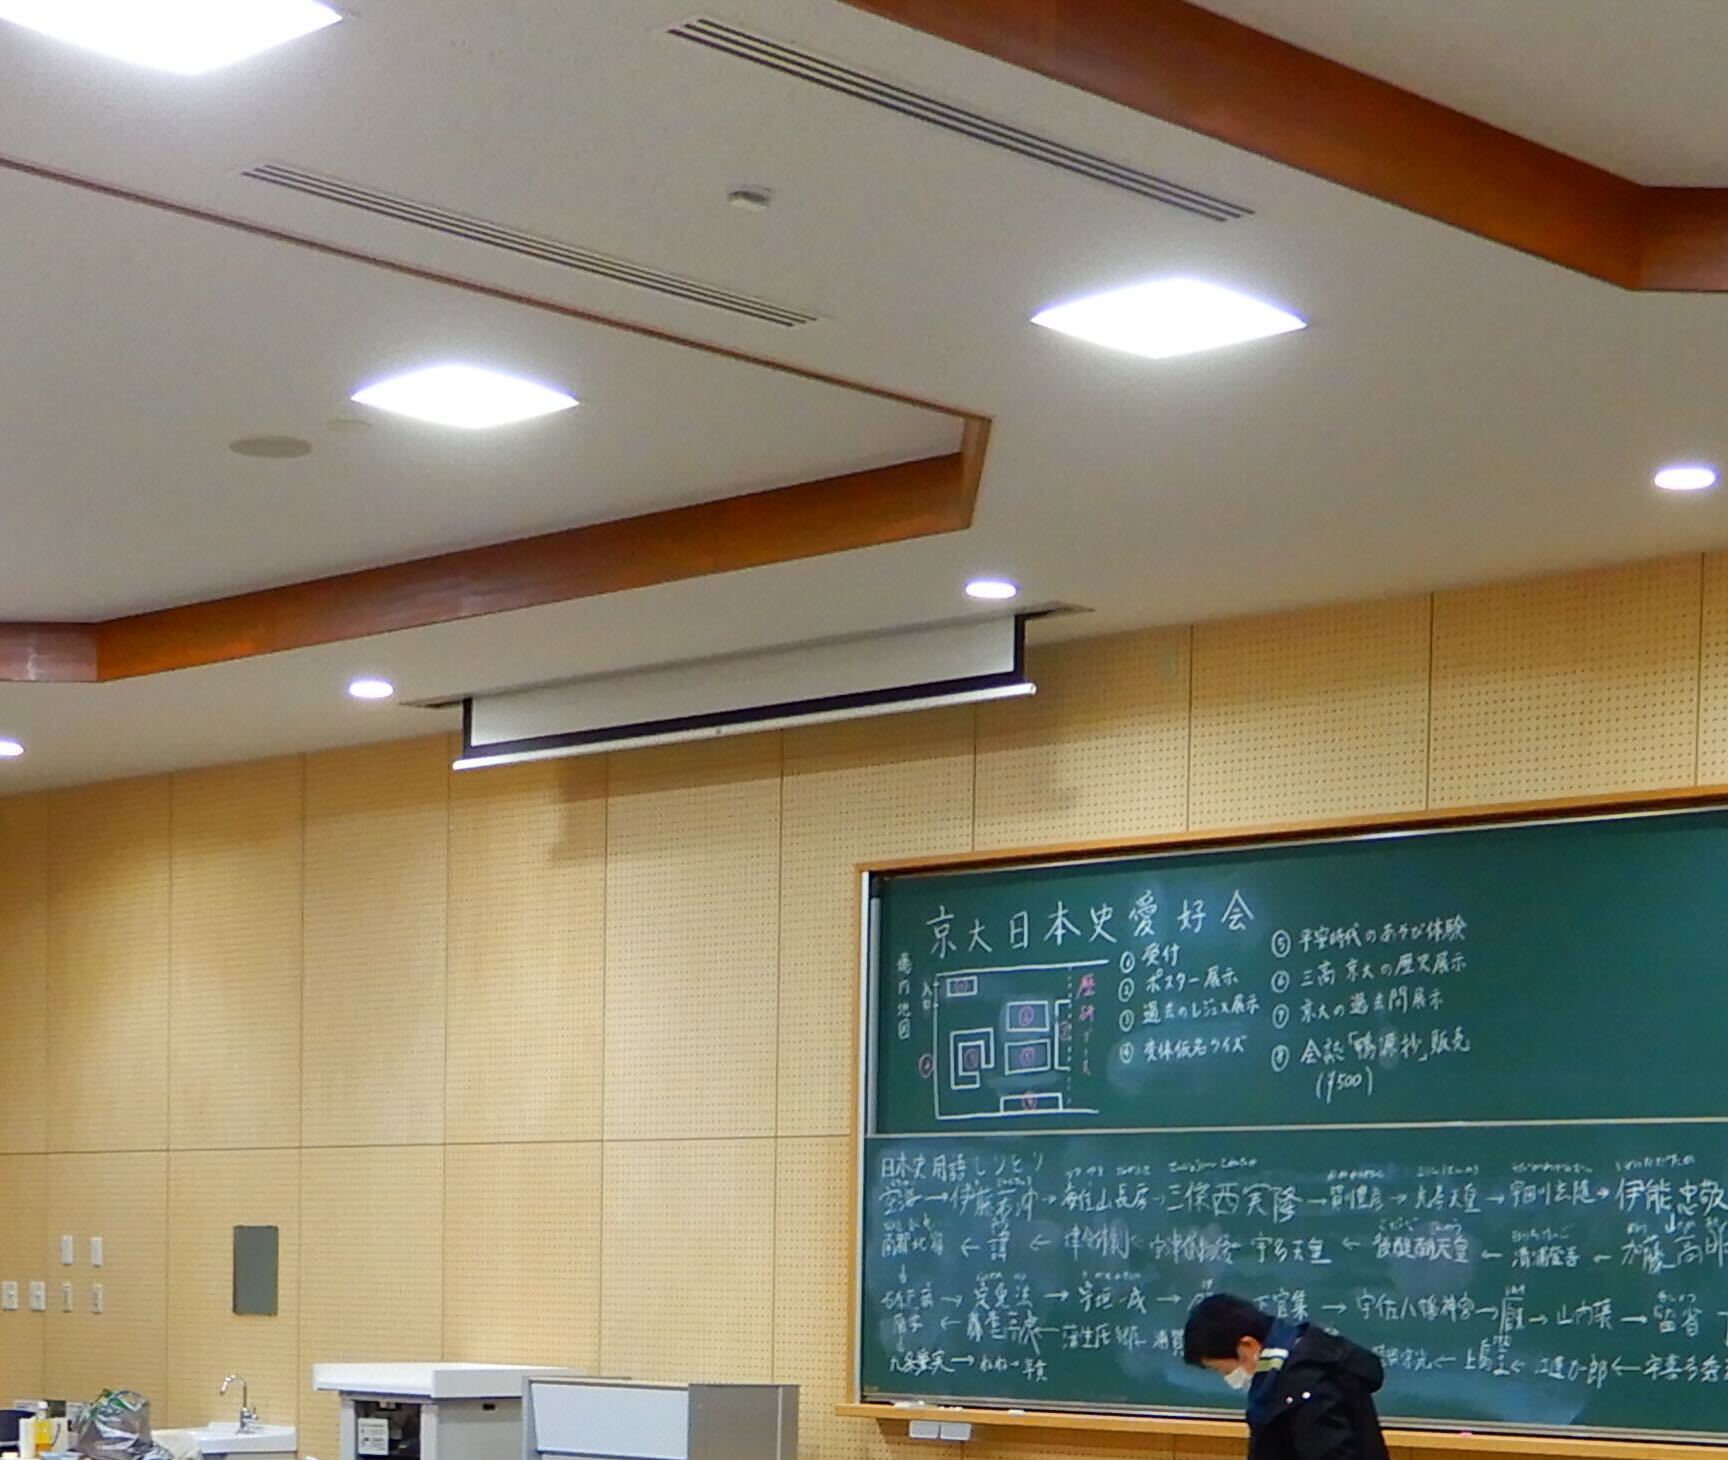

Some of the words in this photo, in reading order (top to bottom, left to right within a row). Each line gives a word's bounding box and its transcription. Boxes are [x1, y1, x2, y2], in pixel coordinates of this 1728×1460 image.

[926, 888, 1255, 959] 京大日本史愛好会
[1141, 943, 1181, 968] 受付
[1145, 964, 1240, 993] ポスター展示
